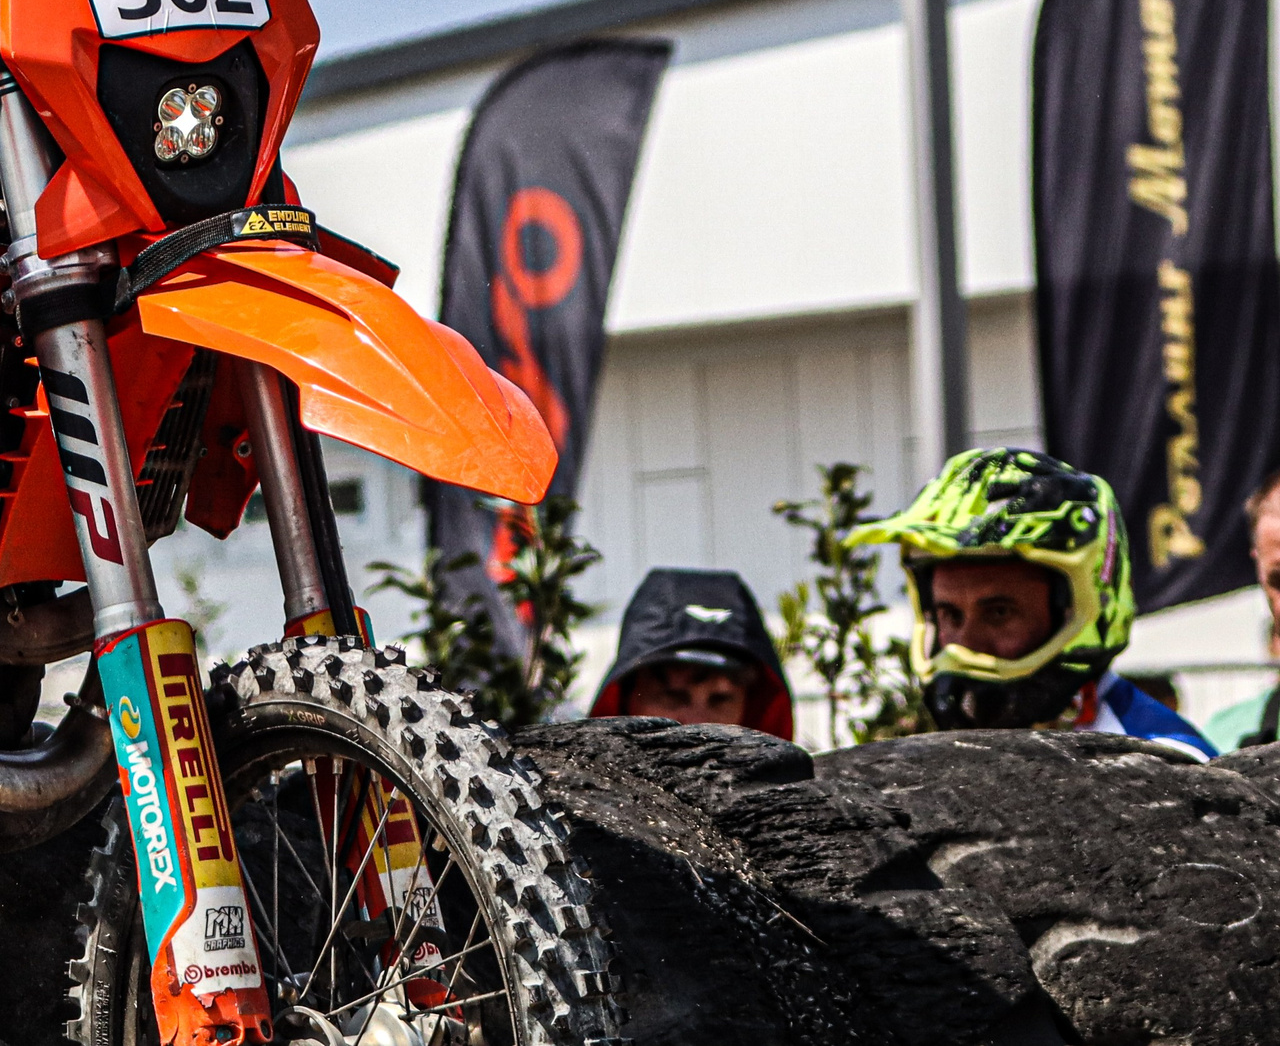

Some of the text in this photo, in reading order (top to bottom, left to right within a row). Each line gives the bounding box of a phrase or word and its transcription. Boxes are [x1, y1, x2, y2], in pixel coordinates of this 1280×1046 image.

[267, 210, 311, 224] ENDURO
[273, 222, 312, 234] ELEMENT
[156, 653, 234, 863] PIRELLI
[125, 741, 177, 895] MOTOREX
[204, 937, 246, 952] GRAPHICS
[203, 960, 258, 979] brembo
